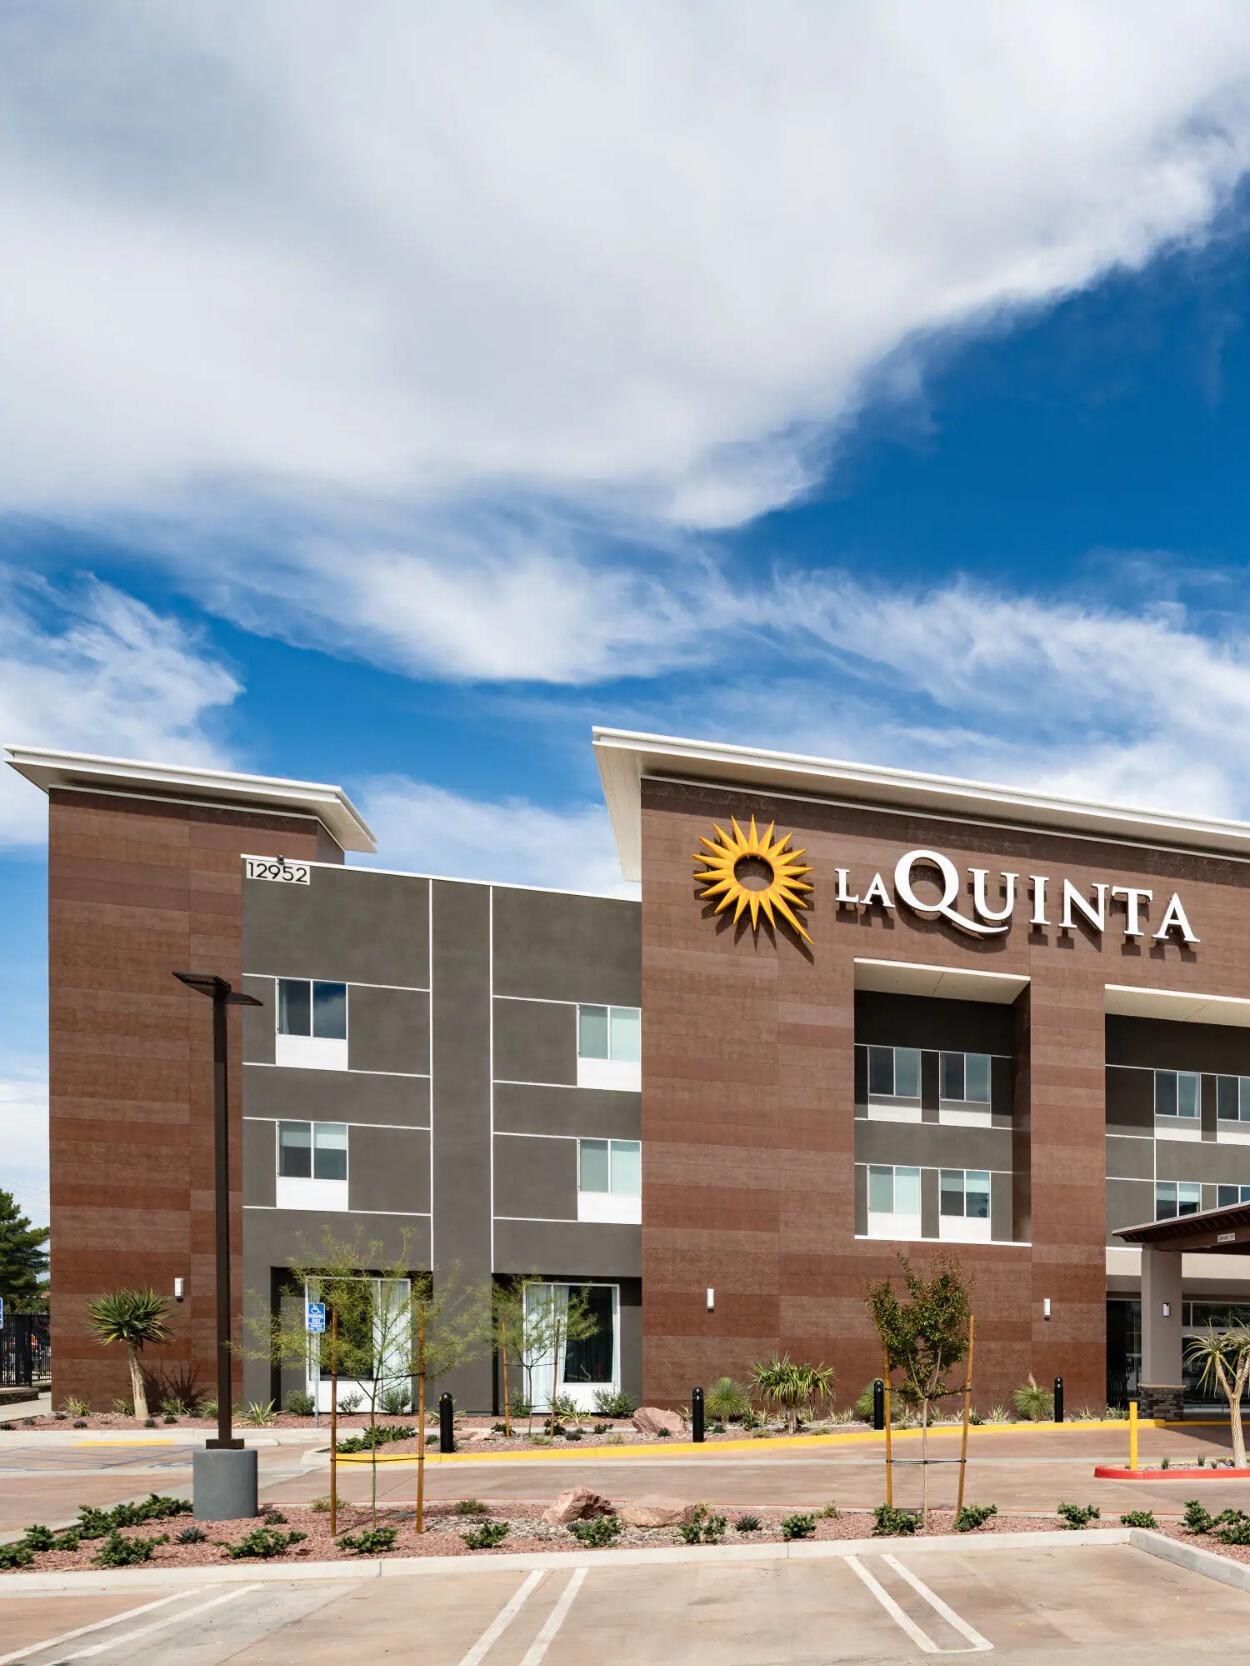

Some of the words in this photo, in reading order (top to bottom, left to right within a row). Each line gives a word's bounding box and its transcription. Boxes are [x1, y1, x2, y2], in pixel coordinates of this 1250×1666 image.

[248, 861, 307, 883] 12952
[834, 867, 896, 908] LA
[894, 849, 1201, 943] QUINTA
